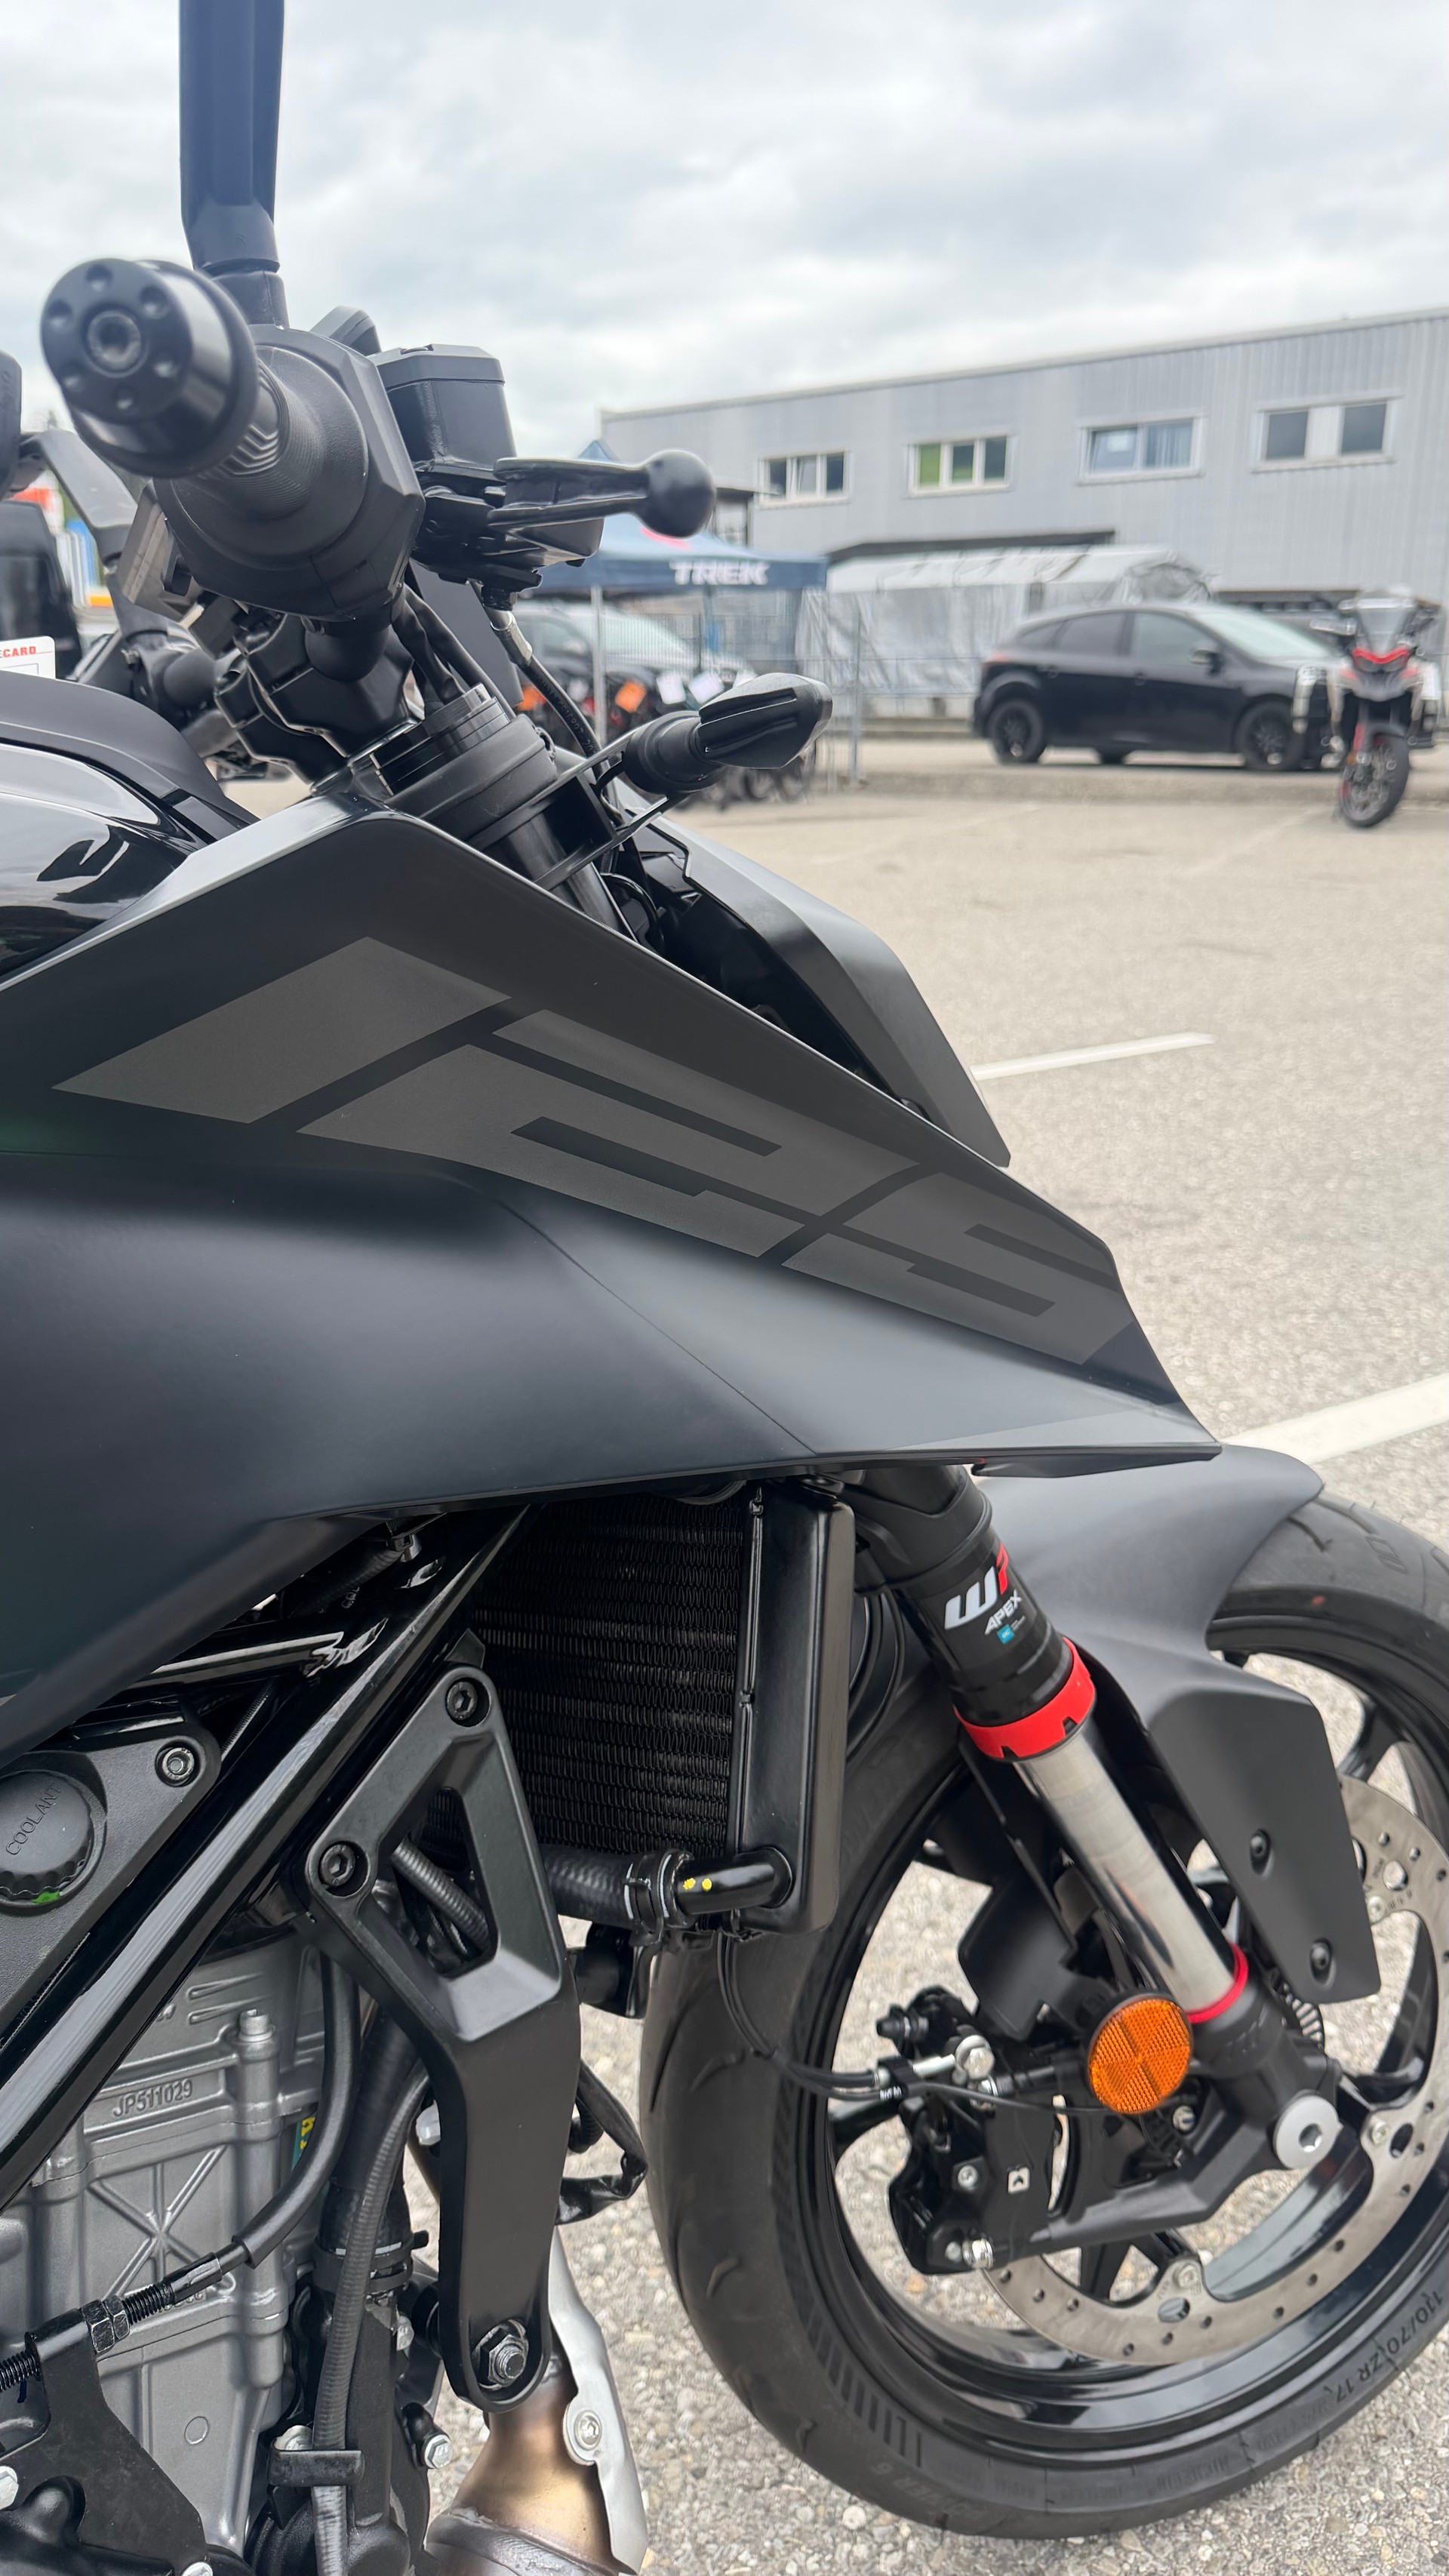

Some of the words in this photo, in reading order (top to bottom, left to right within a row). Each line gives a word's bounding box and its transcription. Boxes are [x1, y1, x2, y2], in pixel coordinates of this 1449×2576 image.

[669, 560, 771, 586] TREK
[984, 1588, 1022, 1636] APEX
[6, 1786, 62, 1855] COOLANT
[112, 2078, 193, 2117] JP511029
[1334, 2378, 1355, 2402] 17
